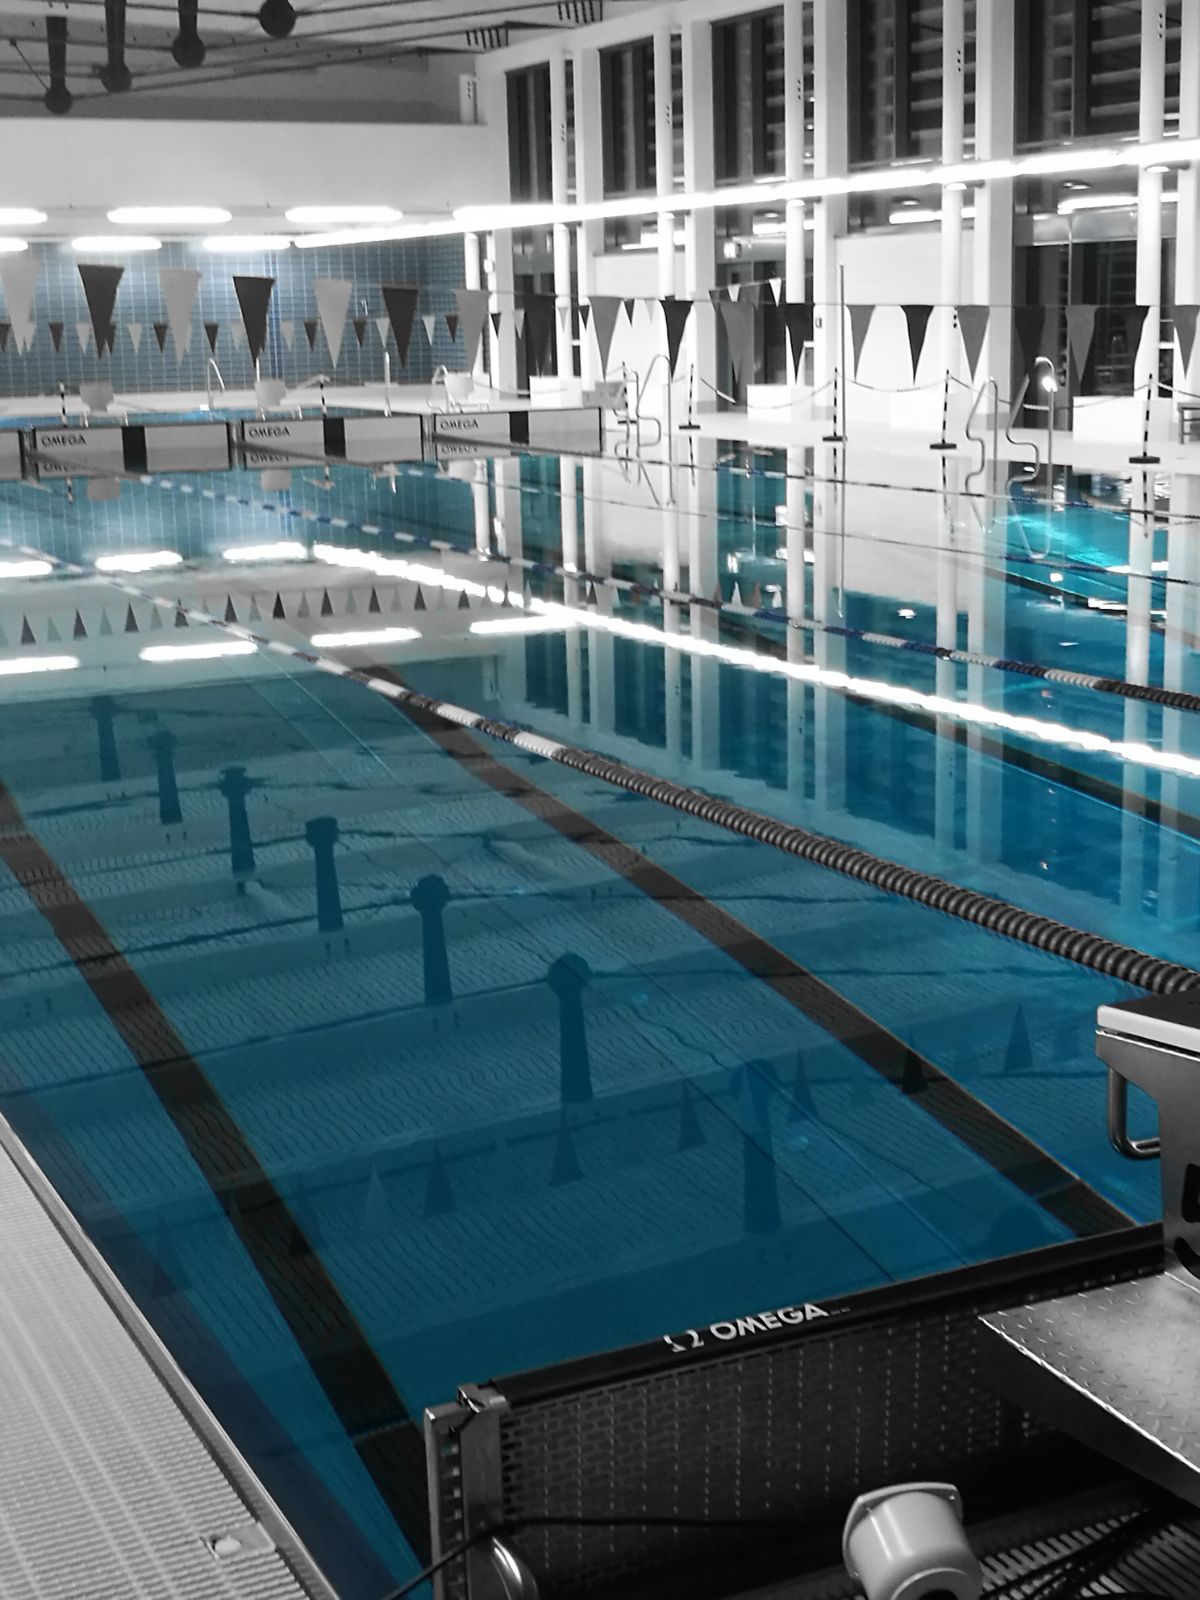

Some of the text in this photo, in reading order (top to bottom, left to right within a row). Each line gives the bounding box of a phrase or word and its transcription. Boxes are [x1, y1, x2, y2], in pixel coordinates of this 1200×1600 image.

[440, 418, 479, 429] OMEGA
[249, 426, 290, 438] OMEGA
[41, 434, 86, 447] OMEGA
[710, 1303, 829, 1339] OMEGA
